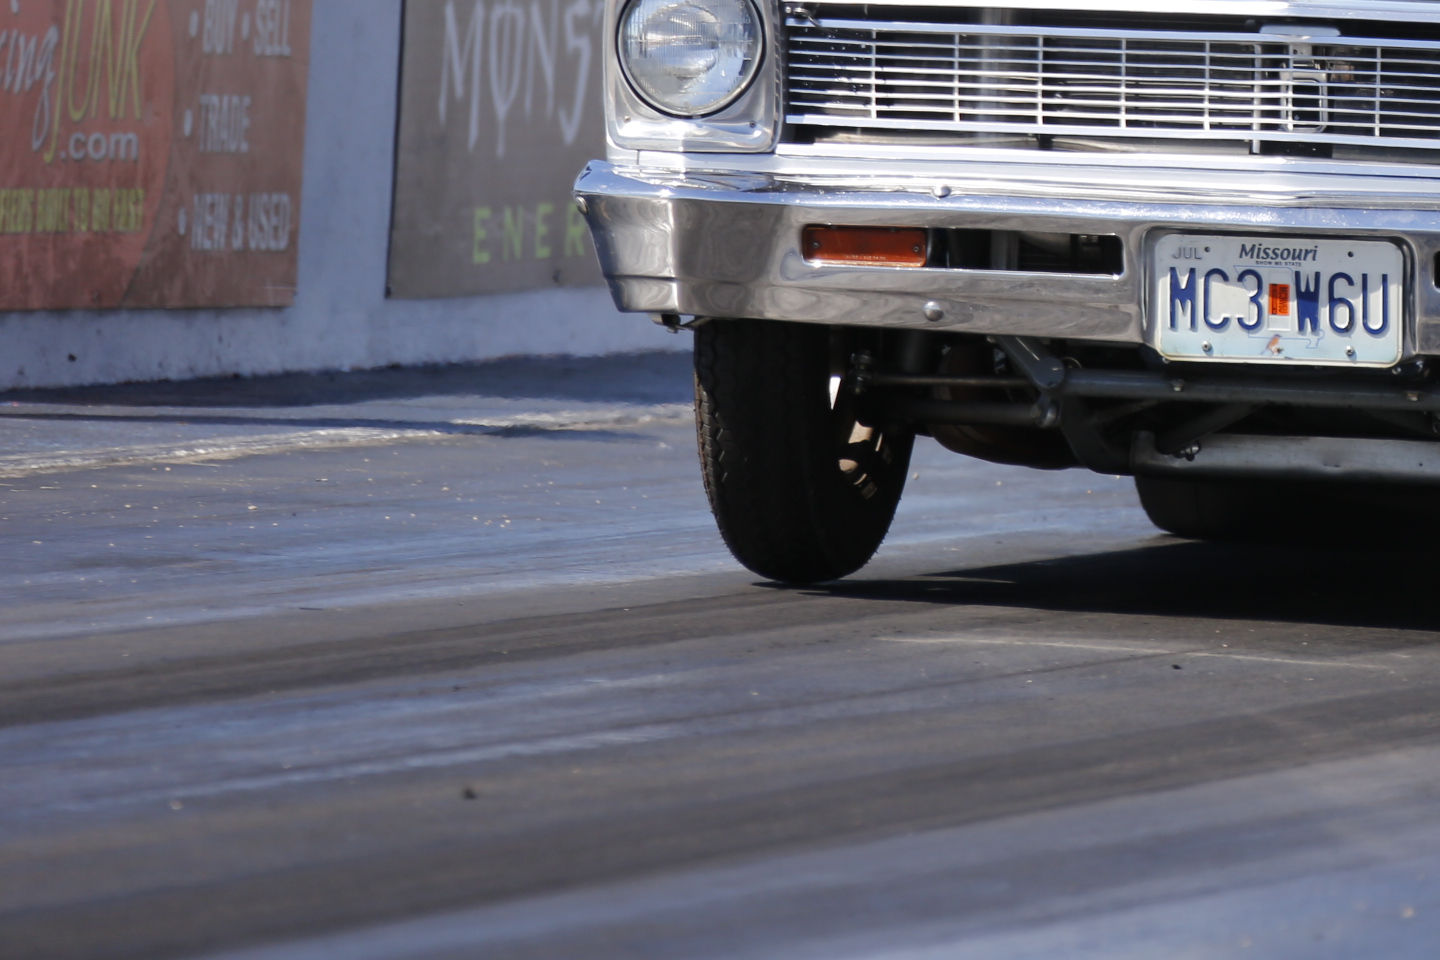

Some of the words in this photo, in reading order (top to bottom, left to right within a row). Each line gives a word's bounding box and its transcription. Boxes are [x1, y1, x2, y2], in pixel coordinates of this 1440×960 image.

[59, 131, 139, 160] .com
[199, 94, 251, 152] TRADE
[191, 193, 230, 251] NEW
[247, 193, 291, 251] USED
[1172, 245, 1203, 260] JUL
[1239, 243, 1319, 262] Missouri
[1168, 266, 1264, 331] MC3
[1294, 270, 1390, 336] W6U
